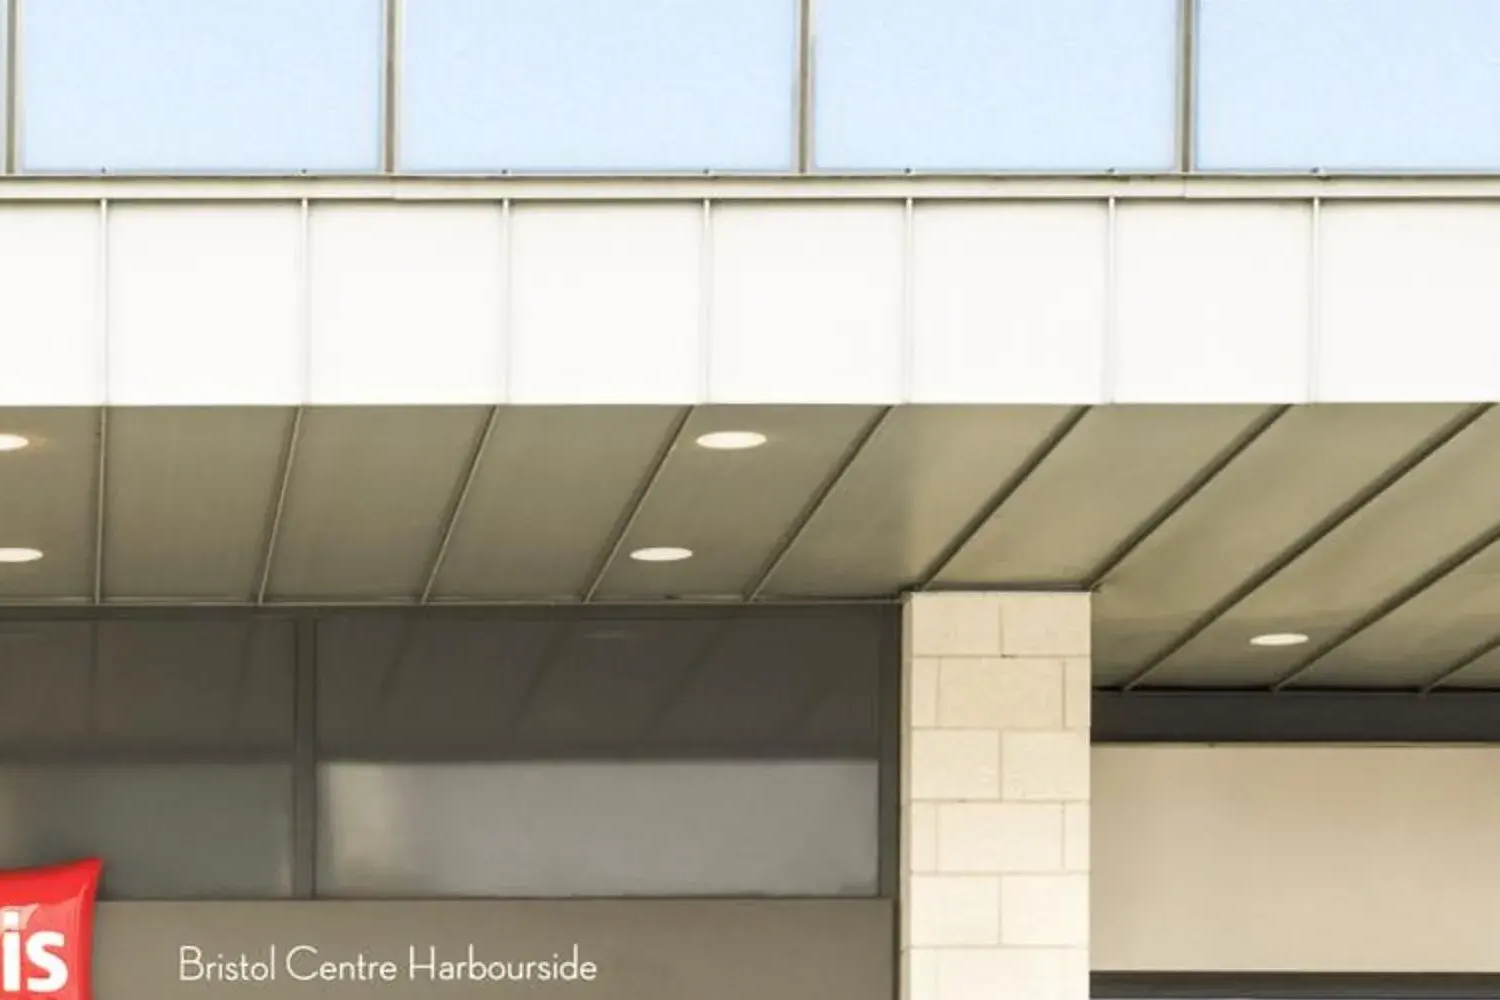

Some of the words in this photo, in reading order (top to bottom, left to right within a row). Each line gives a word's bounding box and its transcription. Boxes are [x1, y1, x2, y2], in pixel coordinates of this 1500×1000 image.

[178, 944, 276, 982] Bristol
[285, 944, 398, 982] Centre
[407, 943, 598, 982] Harbourside
